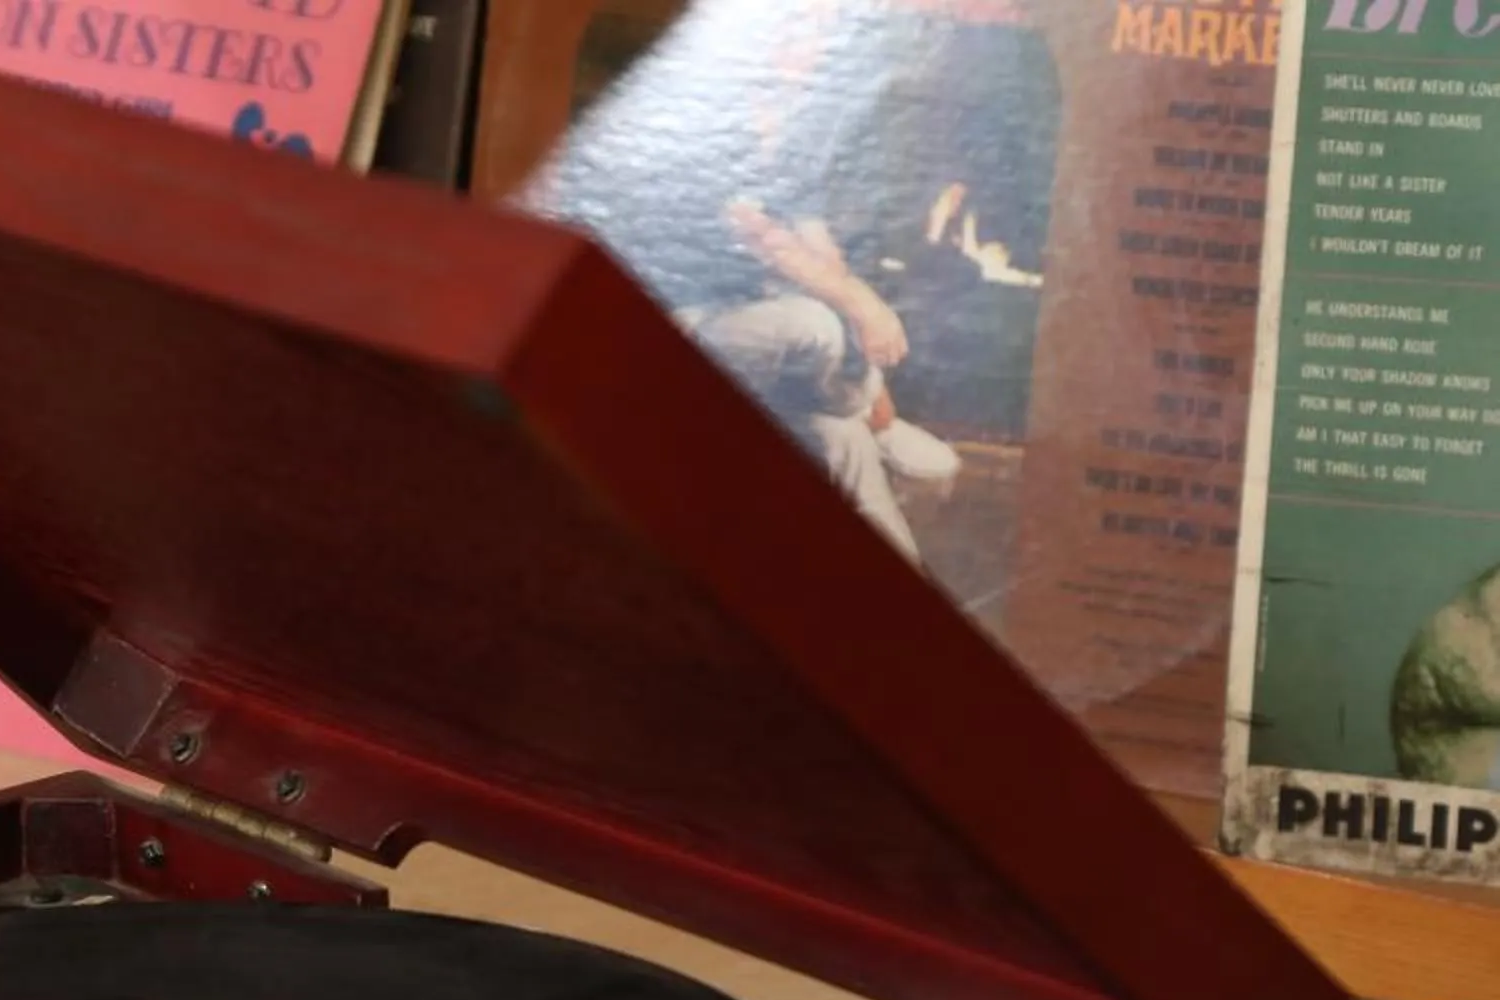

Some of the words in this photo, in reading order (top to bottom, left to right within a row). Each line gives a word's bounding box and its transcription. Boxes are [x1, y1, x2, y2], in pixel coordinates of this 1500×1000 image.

[67, 8, 322, 93] SISTERS
[1373, 77, 1417, 93] NEVER
[1422, 80, 1465, 95] NEVER
[1321, 106, 1389, 124] SHUTTERS
[1394, 111, 1423, 126] AND
[1318, 138, 1364, 156] STAND
[1369, 142, 1384, 157] IN
[1316, 172, 1343, 186] NOT
[1349, 175, 1379, 189] LIKE
[1384, 175, 1393, 189] A
[1400, 176, 1447, 193] SISTER
[1315, 203, 1364, 220] TENDER
[1370, 207, 1412, 224] YEARS
[1321, 236, 1389, 254] WOULDN'T
[1395, 240, 1441, 257] DREAM
[1446, 244, 1463, 260] OF
[1469, 245, 1483, 261] IT
[1328, 301, 1424, 321] UNDERSTANDS
[1430, 308, 1449, 323] ME
[1303, 332, 1355, 349] SECOND
[1301, 364, 1335, 380] ONLY
[1382, 369, 1438, 386] SHADOW
[1358, 399, 1377, 415] UP
[1408, 403, 1442, 419] YOUR
[1447, 406, 1477, 422] WAY
[1296, 425, 1317, 441] AM
[1334, 429, 1368, 445] THAT
[1372, 431, 1407, 448] EASY
[1413, 434, 1430, 450] TO
[1434, 437, 1484, 456] FORGET
[1295, 457, 1318, 474] THE
[1324, 460, 1368, 479] THRILL
[1374, 464, 1388, 480] IS
[1393, 465, 1428, 485] GONE
[1277, 784, 1498, 852] PHILIP
